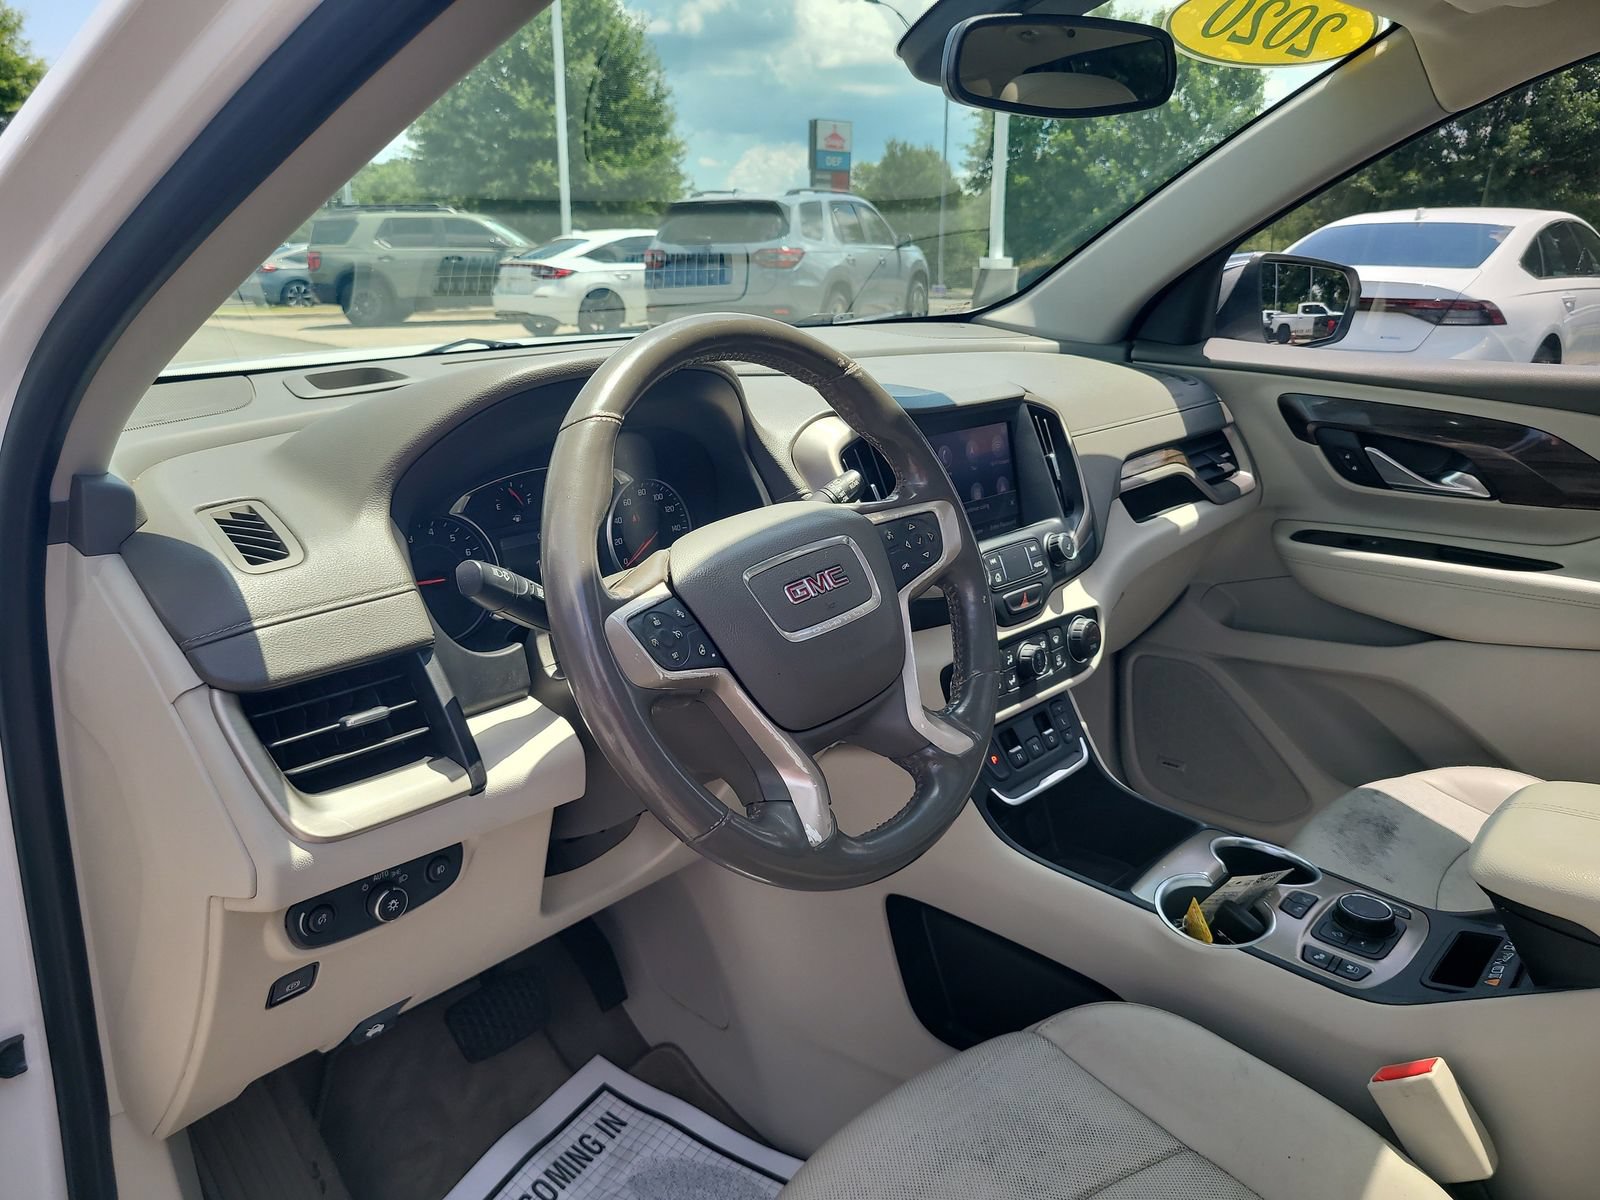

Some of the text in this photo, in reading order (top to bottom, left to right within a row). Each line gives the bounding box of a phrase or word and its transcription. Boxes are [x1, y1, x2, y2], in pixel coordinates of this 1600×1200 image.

[637, 489, 647, 497] 80
[653, 493, 664, 501] 100
[623, 498, 632, 506] 60
[664, 505, 675, 513] 120
[614, 516, 623, 524] 40
[428, 528, 434, 536] 4
[671, 524, 682, 532] 140
[450, 534, 456, 542] 5
[614, 537, 623, 546] 20
[465, 548, 472, 557] 6
[784, 564, 850, 605] GMC
[991, 754, 999, 765] P
[1016, 753, 1023, 761] R
[373, 870, 389, 881] AUTO
[593, 1110, 629, 1140] IN
